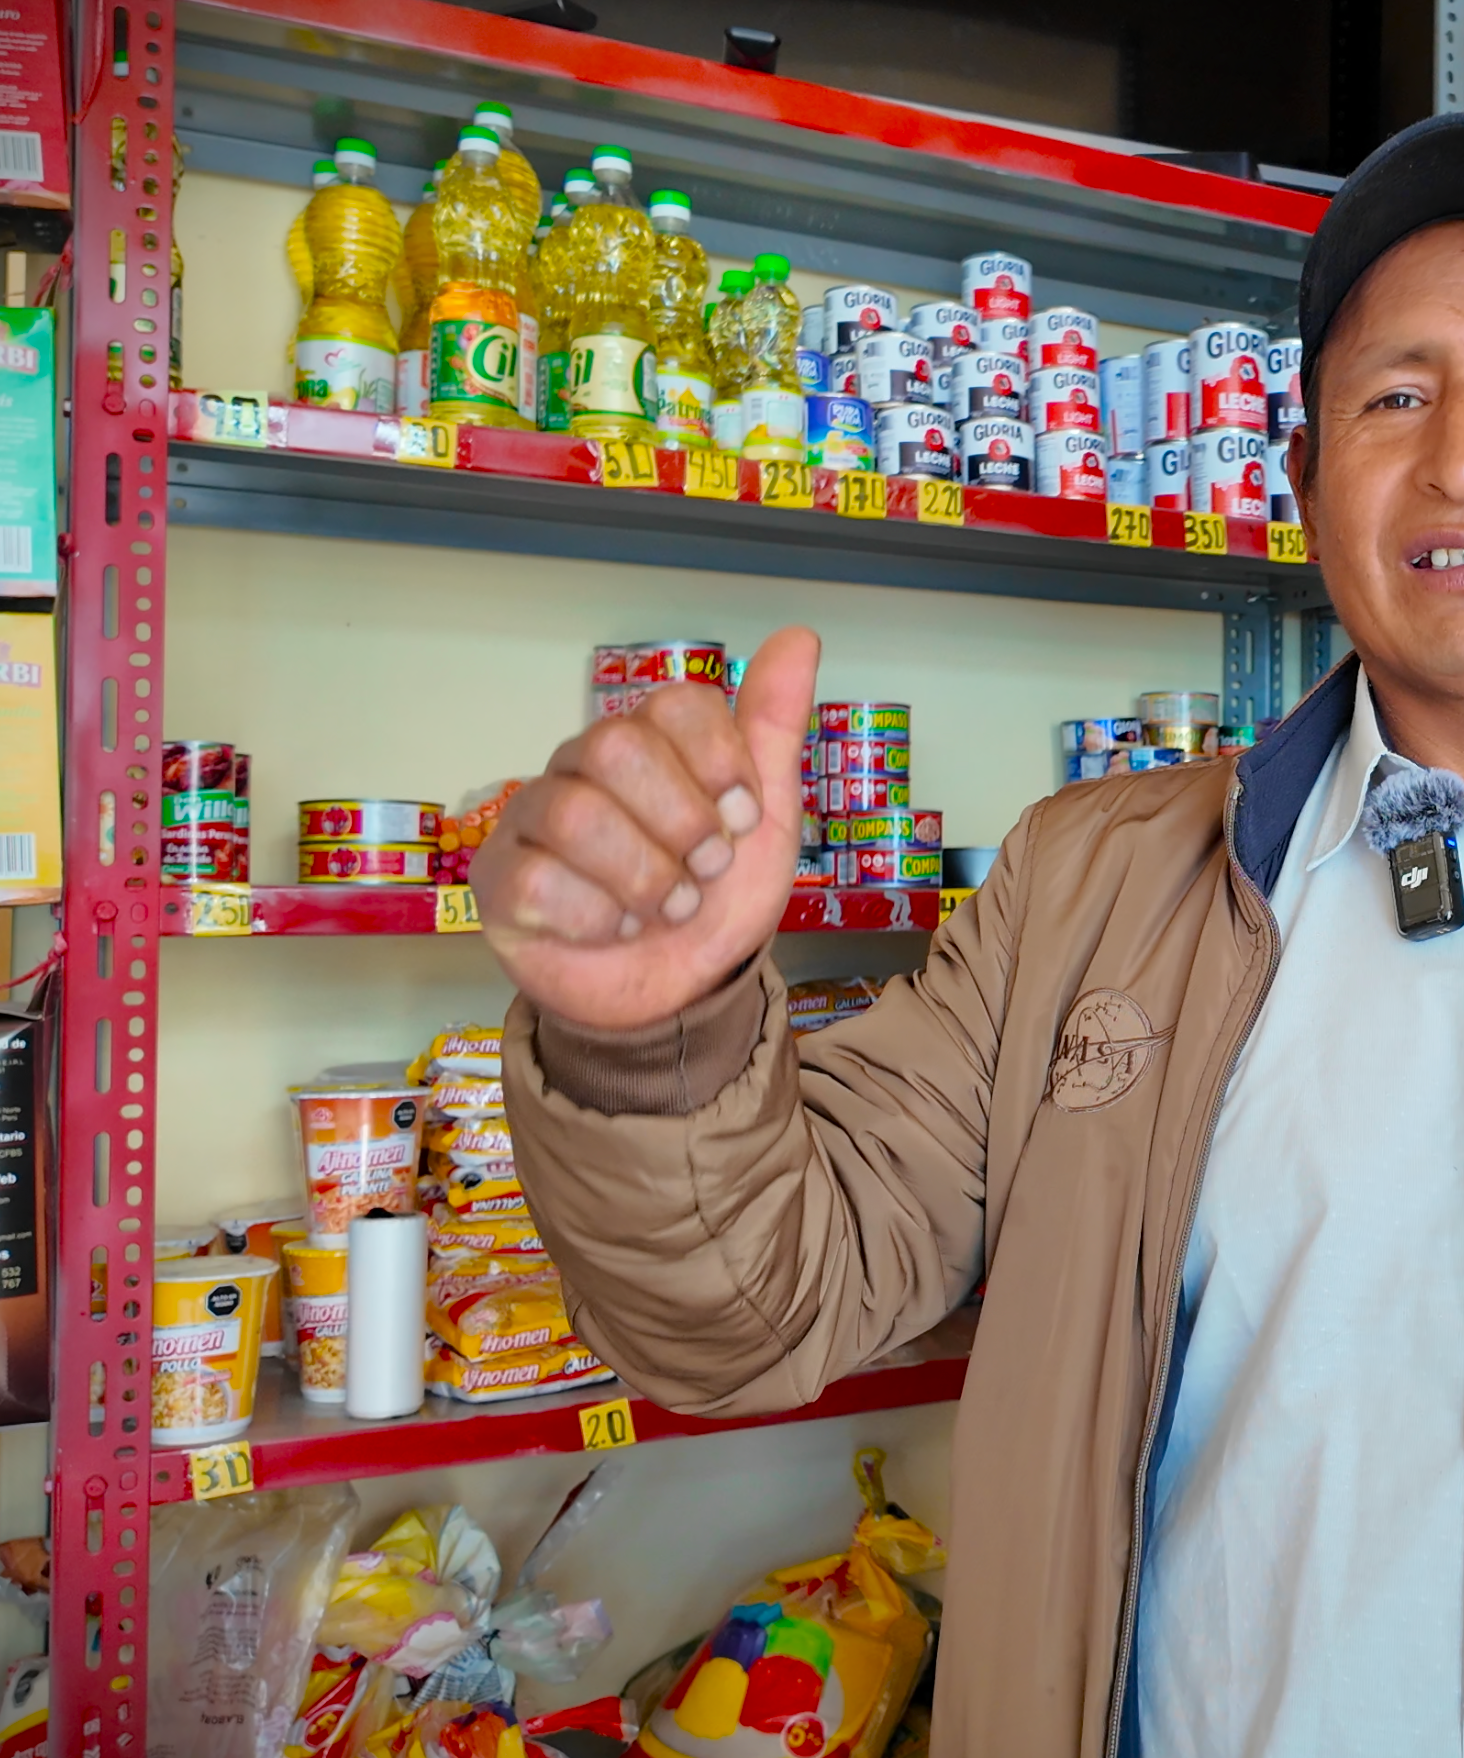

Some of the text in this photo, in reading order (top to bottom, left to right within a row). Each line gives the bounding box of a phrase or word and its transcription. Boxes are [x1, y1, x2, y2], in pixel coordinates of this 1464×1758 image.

[979, 259, 1025, 278] GLORIA
[973, 423, 1023, 443] GLORIA
[851, 819, 911, 841] COMPASS
[902, 855, 942, 877] COMPA
[1401, 866, 1429, 889] dji
[585, 1408, 627, 1450] 2.0
